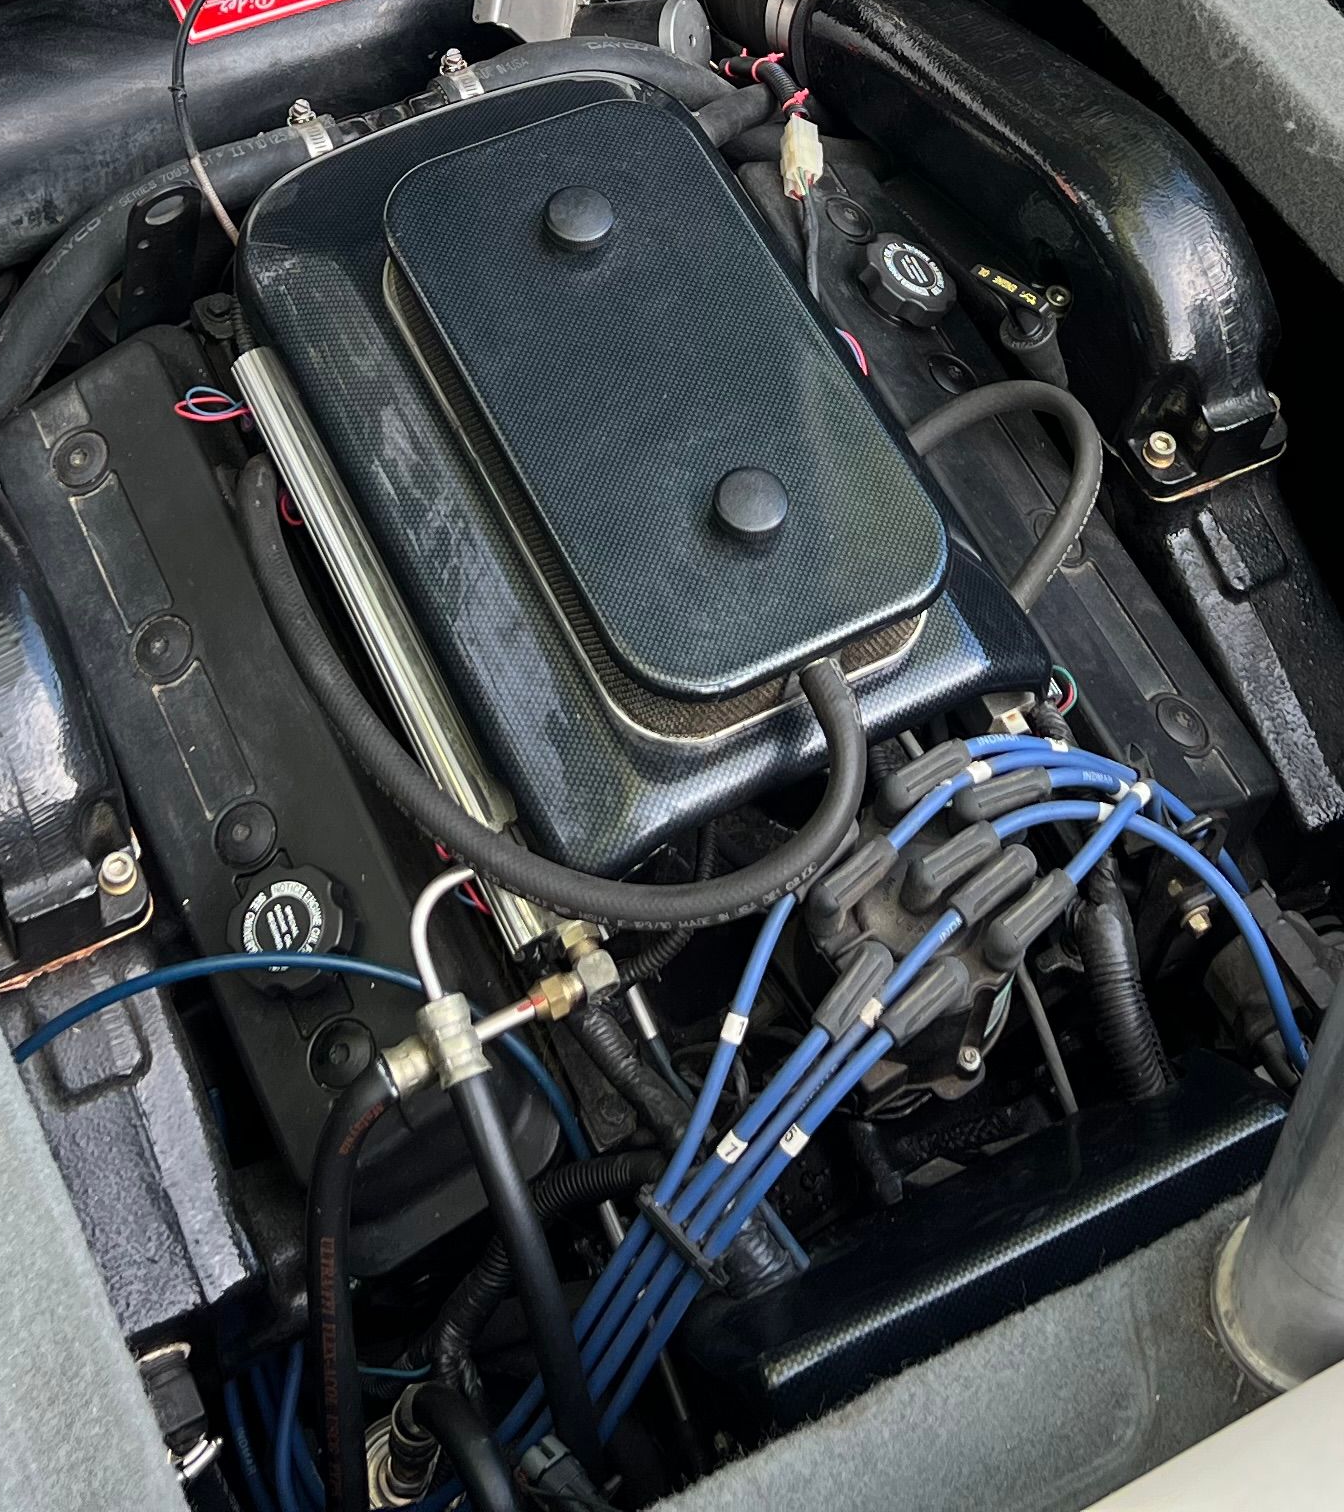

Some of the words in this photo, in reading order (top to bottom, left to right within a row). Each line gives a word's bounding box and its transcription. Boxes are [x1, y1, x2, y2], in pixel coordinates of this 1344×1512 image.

[44, 216, 103, 275] DAYCO
[118, 178, 158, 208] SERIES
[678, 917, 710, 928] MADE
